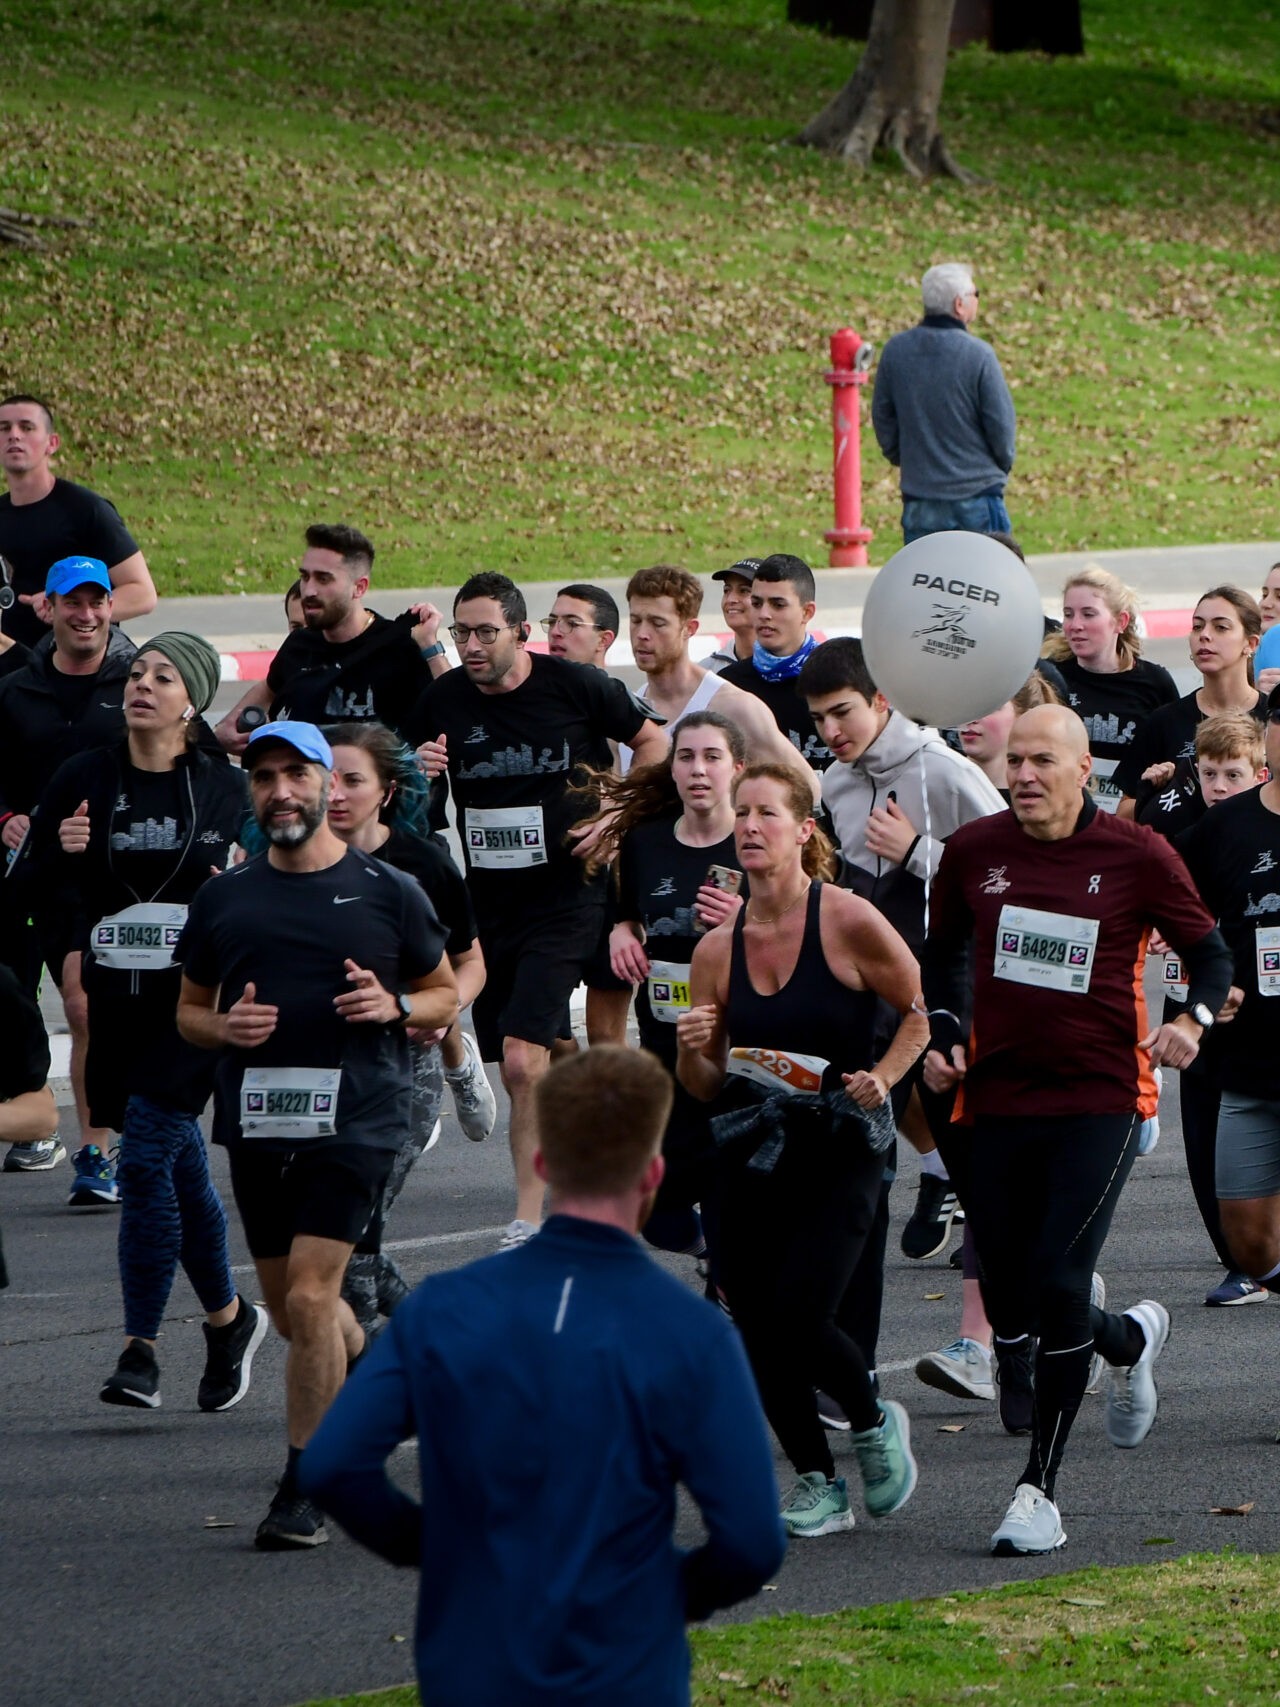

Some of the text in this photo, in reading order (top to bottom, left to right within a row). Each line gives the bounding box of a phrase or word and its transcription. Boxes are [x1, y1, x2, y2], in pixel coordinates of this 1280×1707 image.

[912, 573, 1000, 606] PACER
[485, 830, 522, 848] 55114
[118, 926, 161, 946] 50432
[1021, 935, 1067, 963] 54829
[267, 1092, 311, 1113] 54227
